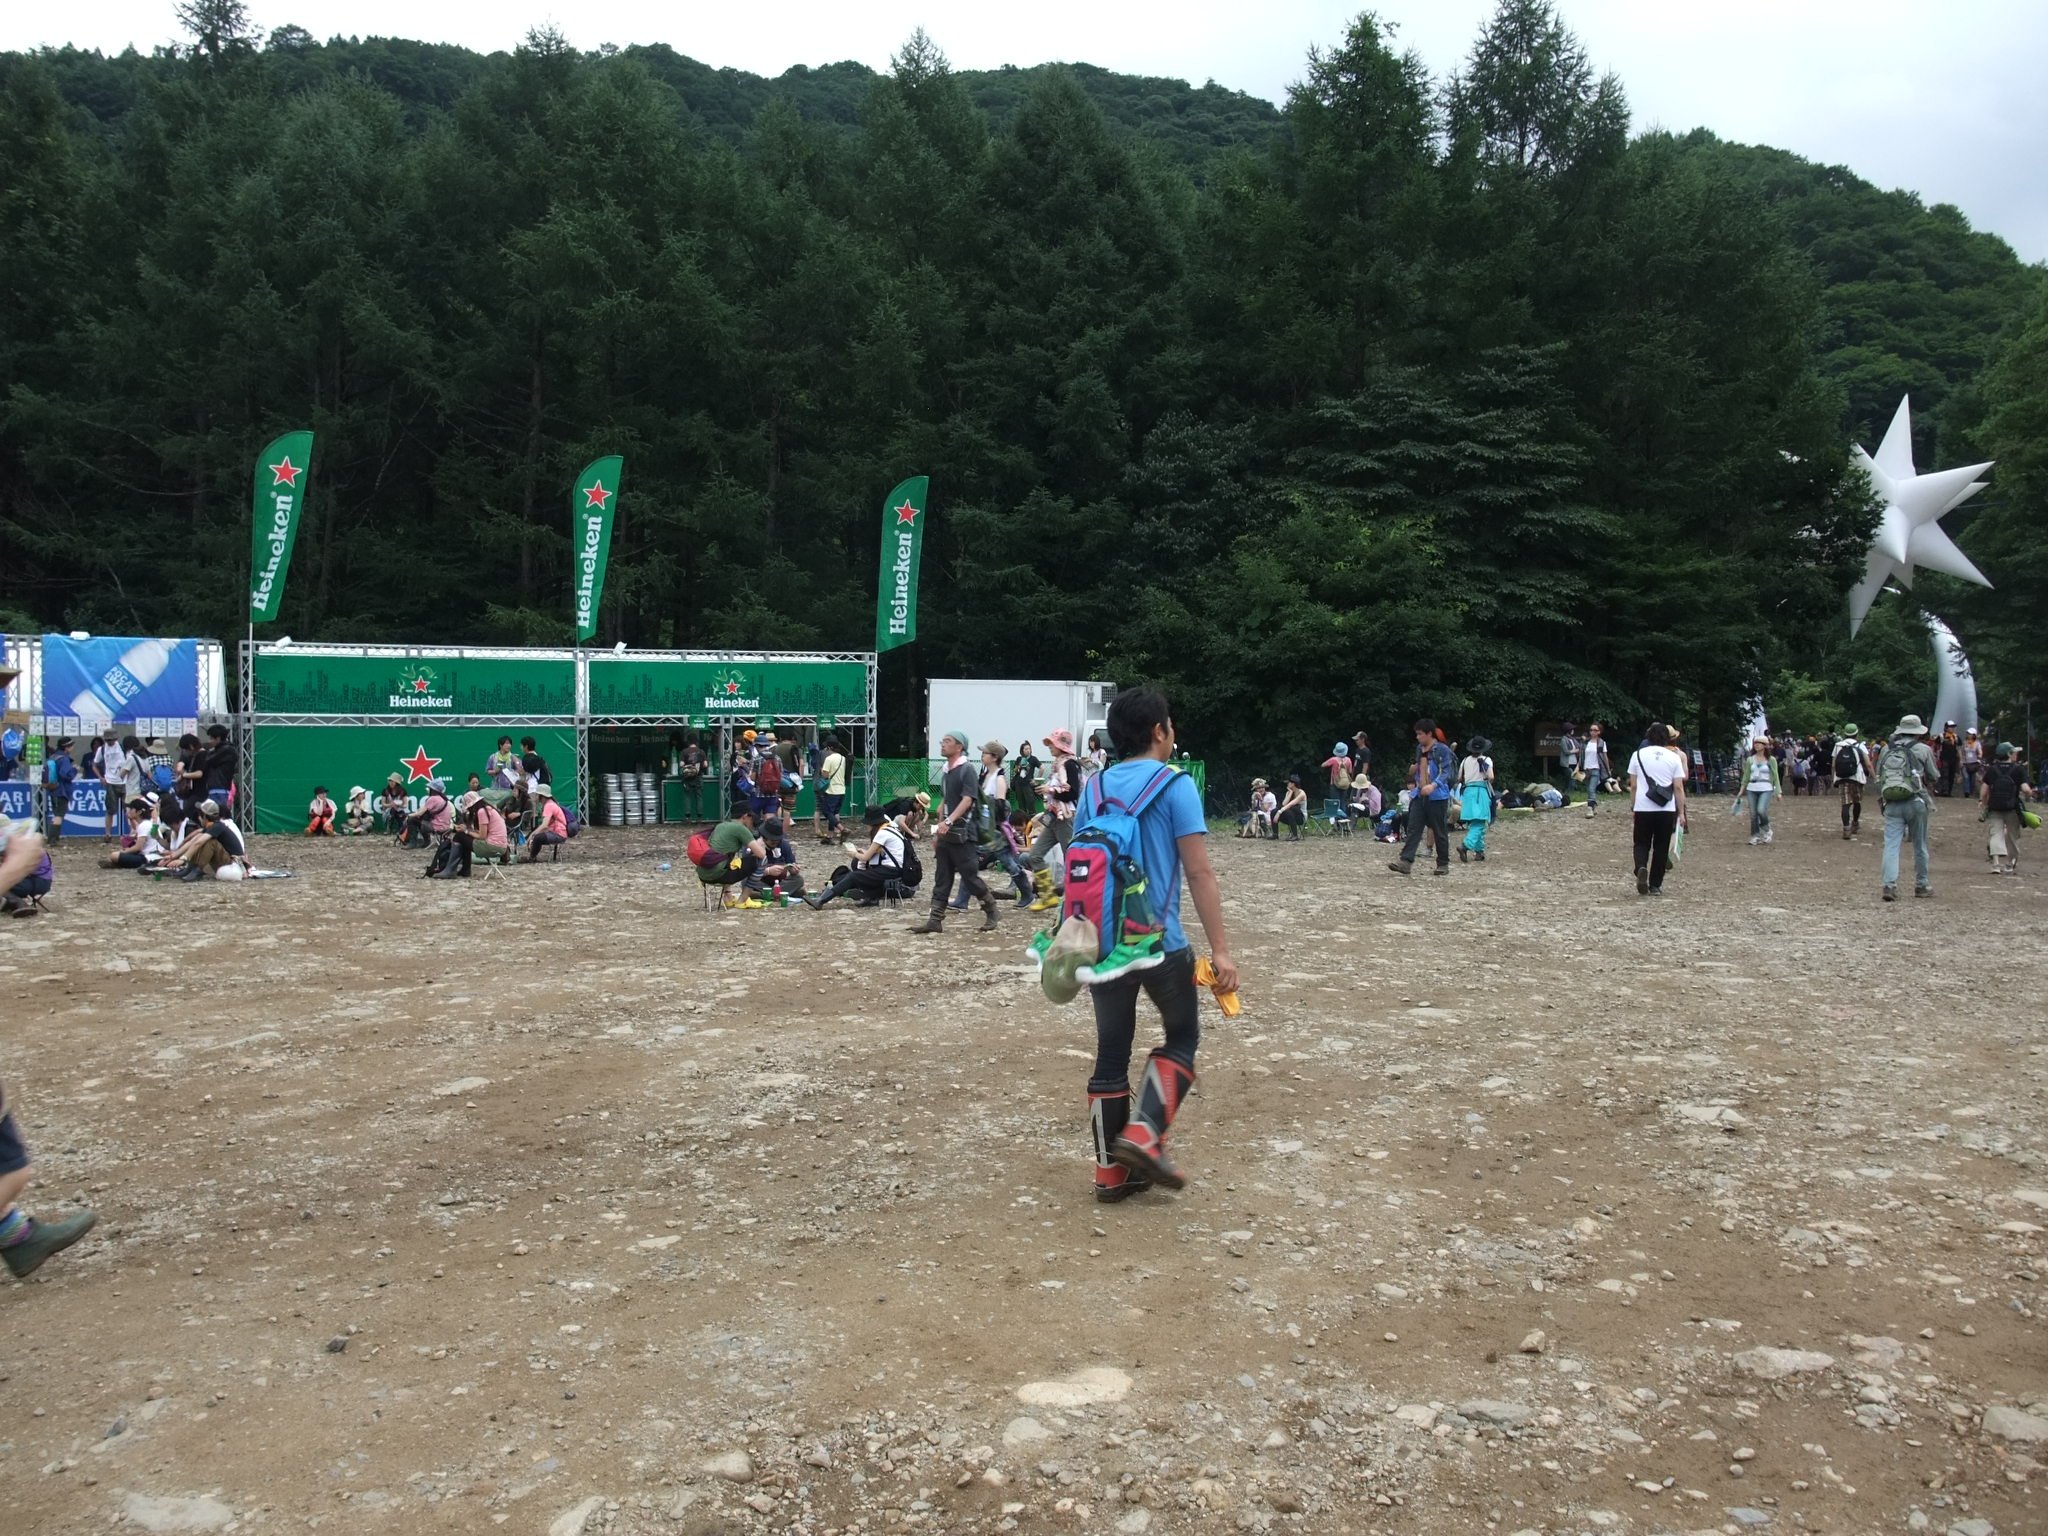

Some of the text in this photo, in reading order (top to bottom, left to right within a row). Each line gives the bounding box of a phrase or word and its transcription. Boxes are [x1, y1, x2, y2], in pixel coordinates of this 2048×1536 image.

[252, 494, 293, 611] Heineken
[577, 515, 602, 628] Heineken
[889, 532, 912, 634] Heineken
[104, 671, 132, 697] SWEAT
[109, 666, 141, 695] POCARI
[389, 695, 453, 707] Heineken
[705, 697, 759, 708] Heineken
[0, 791, 31, 802] ARI
[48, 801, 107, 812] WEAT
